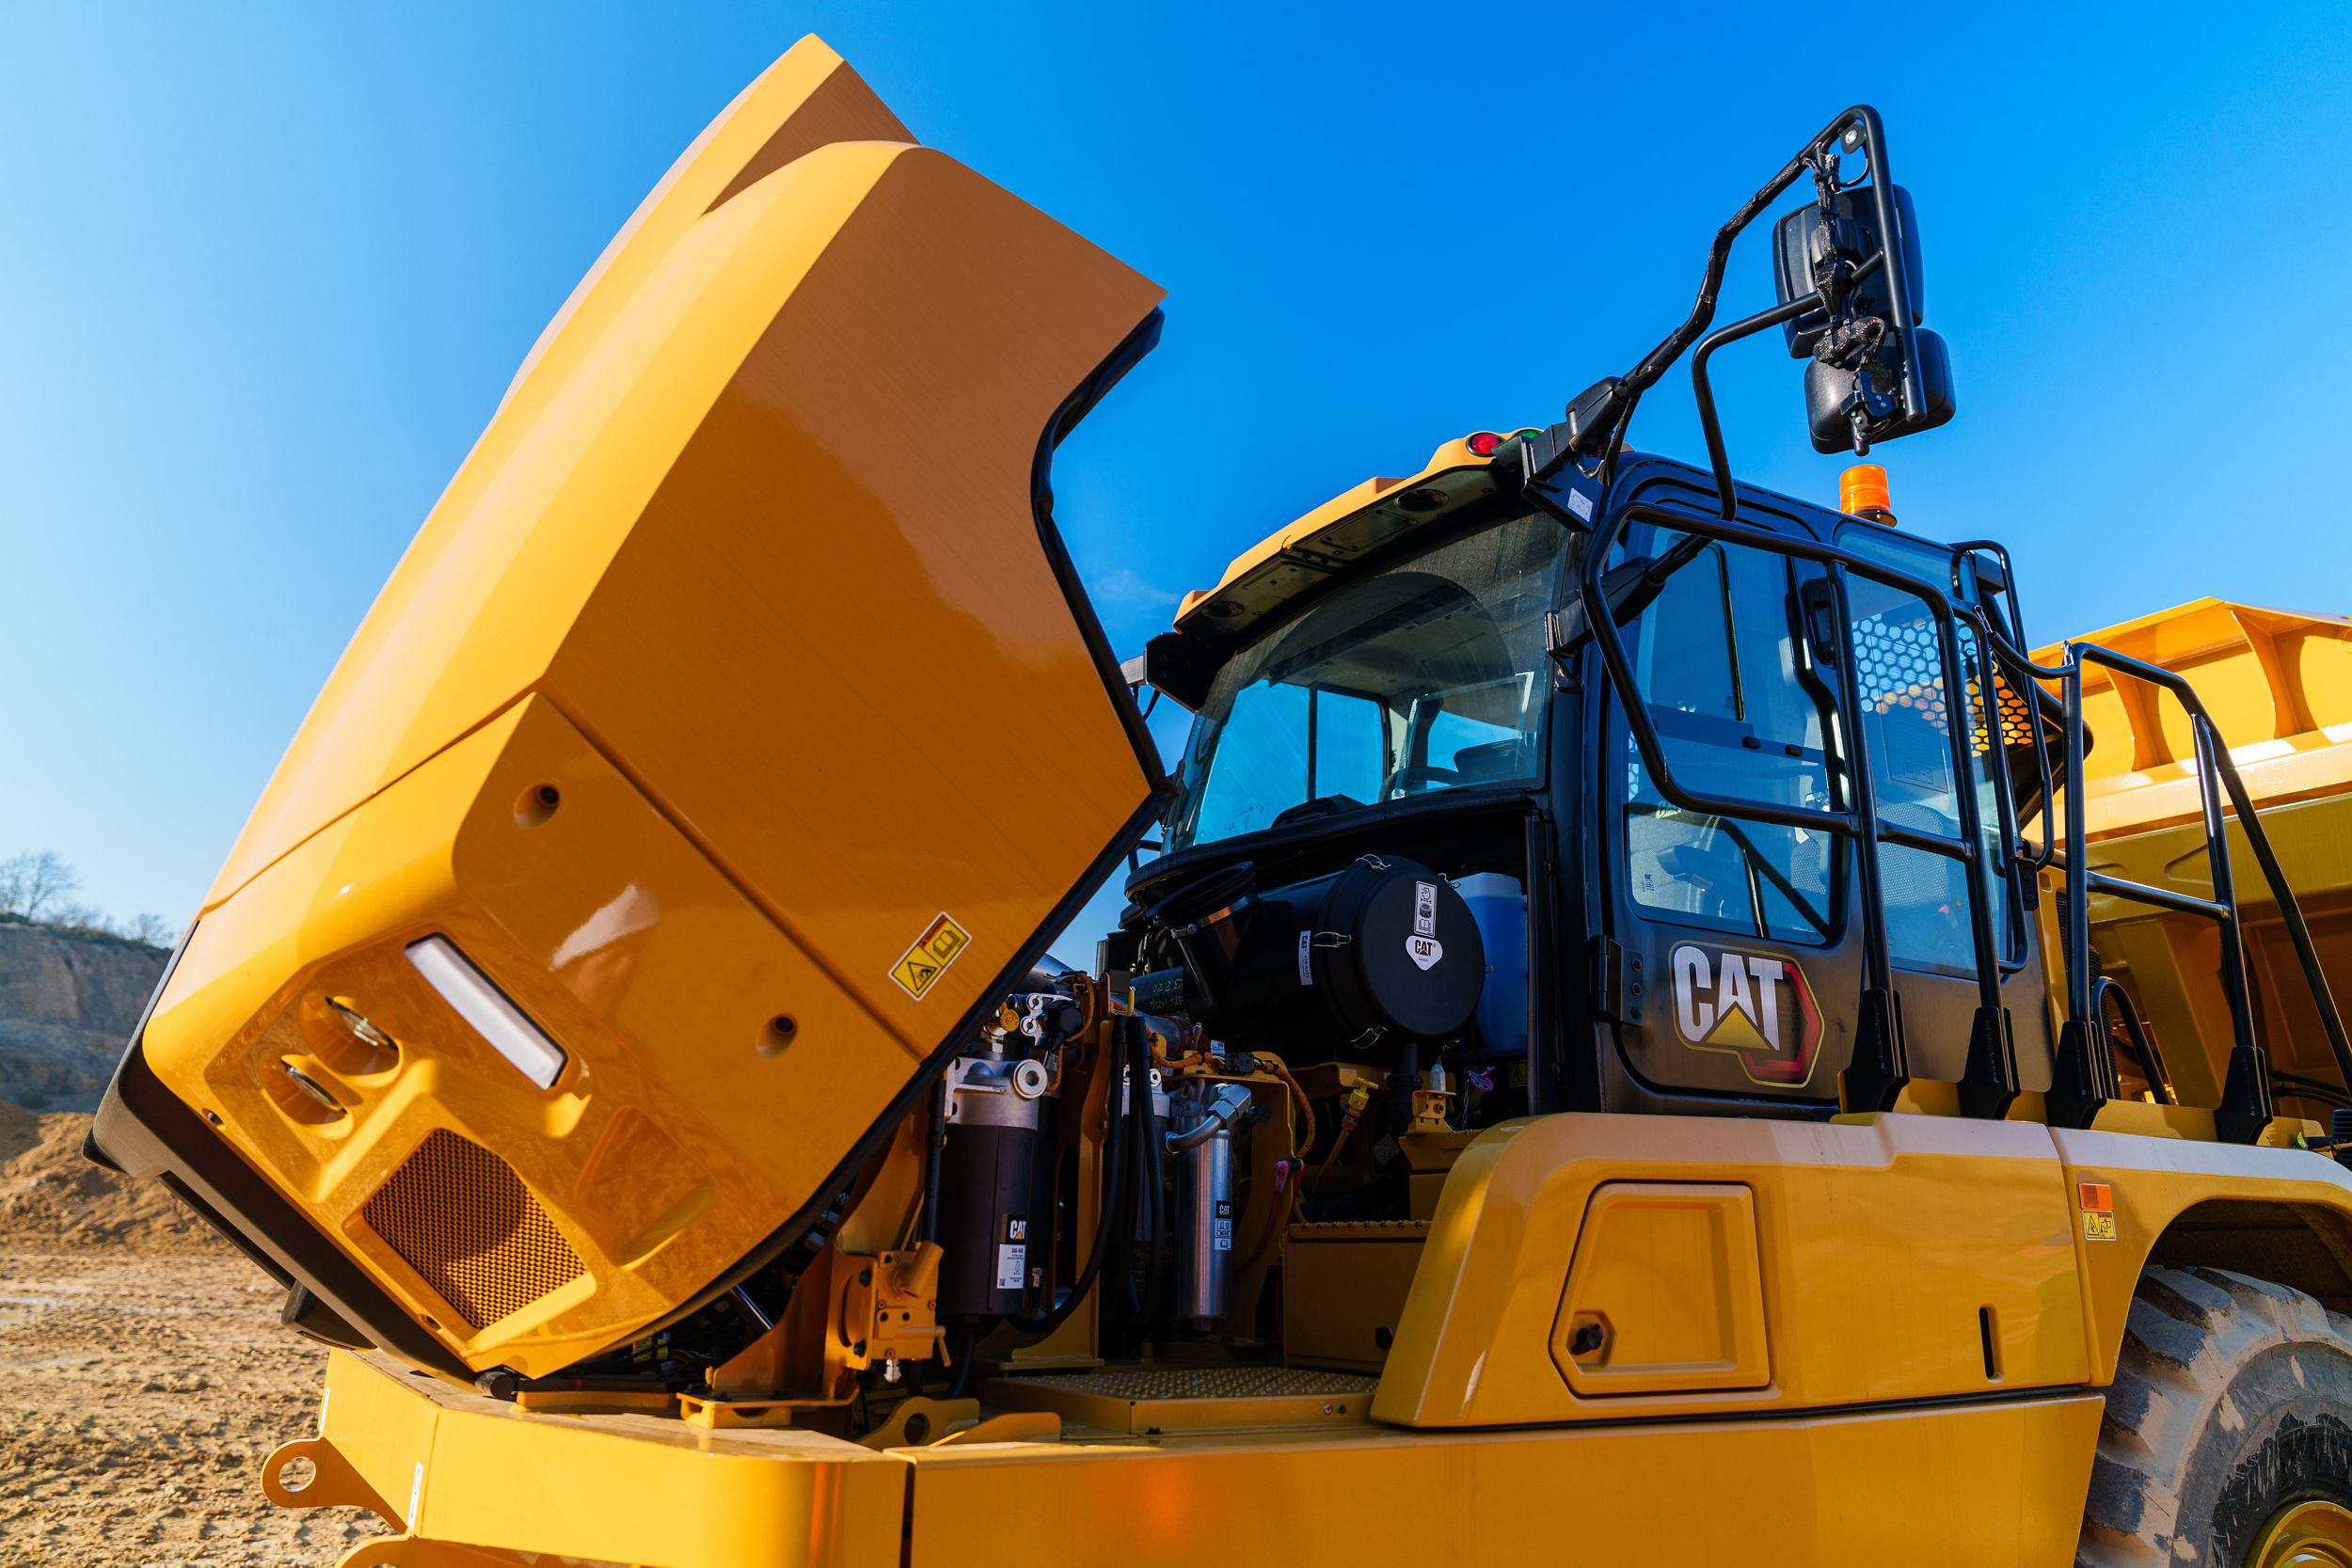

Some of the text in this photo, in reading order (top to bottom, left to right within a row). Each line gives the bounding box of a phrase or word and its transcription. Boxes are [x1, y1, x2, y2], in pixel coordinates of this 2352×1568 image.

[1415, 940, 1433, 957] CAT
[1674, 946, 1784, 1051] CAT
[1219, 1205, 1231, 1215] CAT
[1009, 1220, 1026, 1240] CAT
